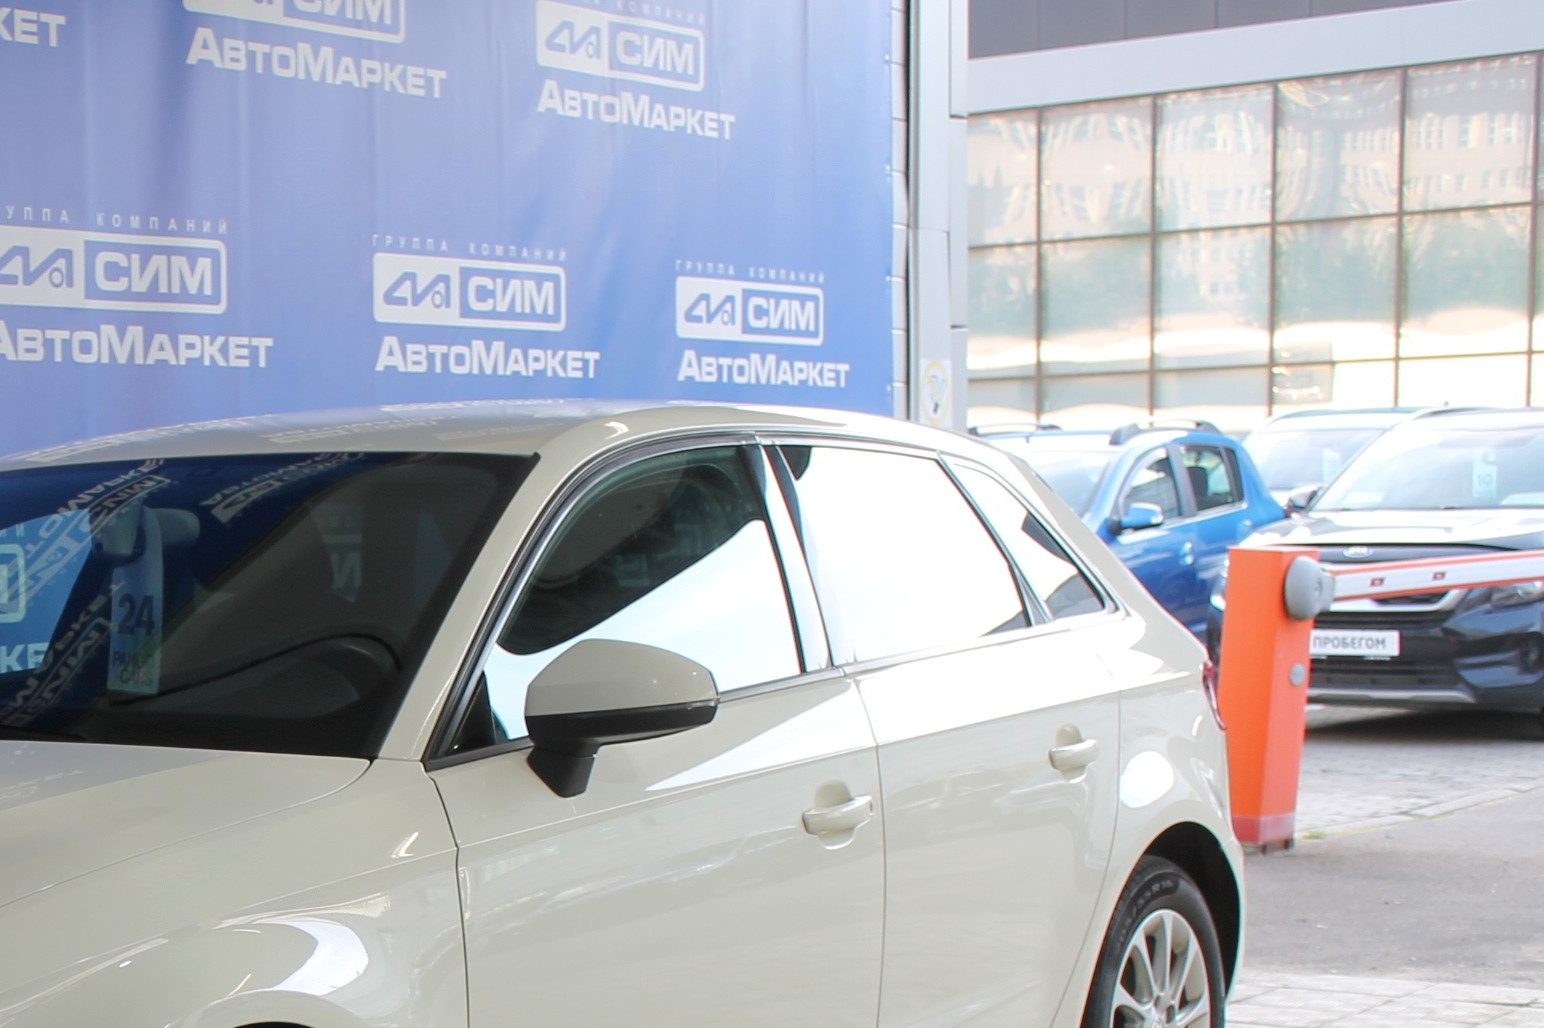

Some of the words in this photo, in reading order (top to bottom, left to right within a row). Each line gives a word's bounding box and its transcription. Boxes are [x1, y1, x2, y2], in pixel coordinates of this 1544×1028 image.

[616, 30, 695, 75] СИМ
[97, 213, 228, 235] КОМПАНИЙ
[372, 234, 447, 252] ГРУППА
[469, 242, 567, 262] КОМПАНИЙ
[95, 251, 213, 294] СИМ
[676, 259, 736, 276] ГРУППА
[749, 265, 826, 285] КОМПАНИЙ
[467, 275, 556, 314] СИМ
[747, 296, 817, 332] СИМ
[118, 594, 155, 635] 24
[1313, 636, 1387, 650] ПРОБЕГОМ
